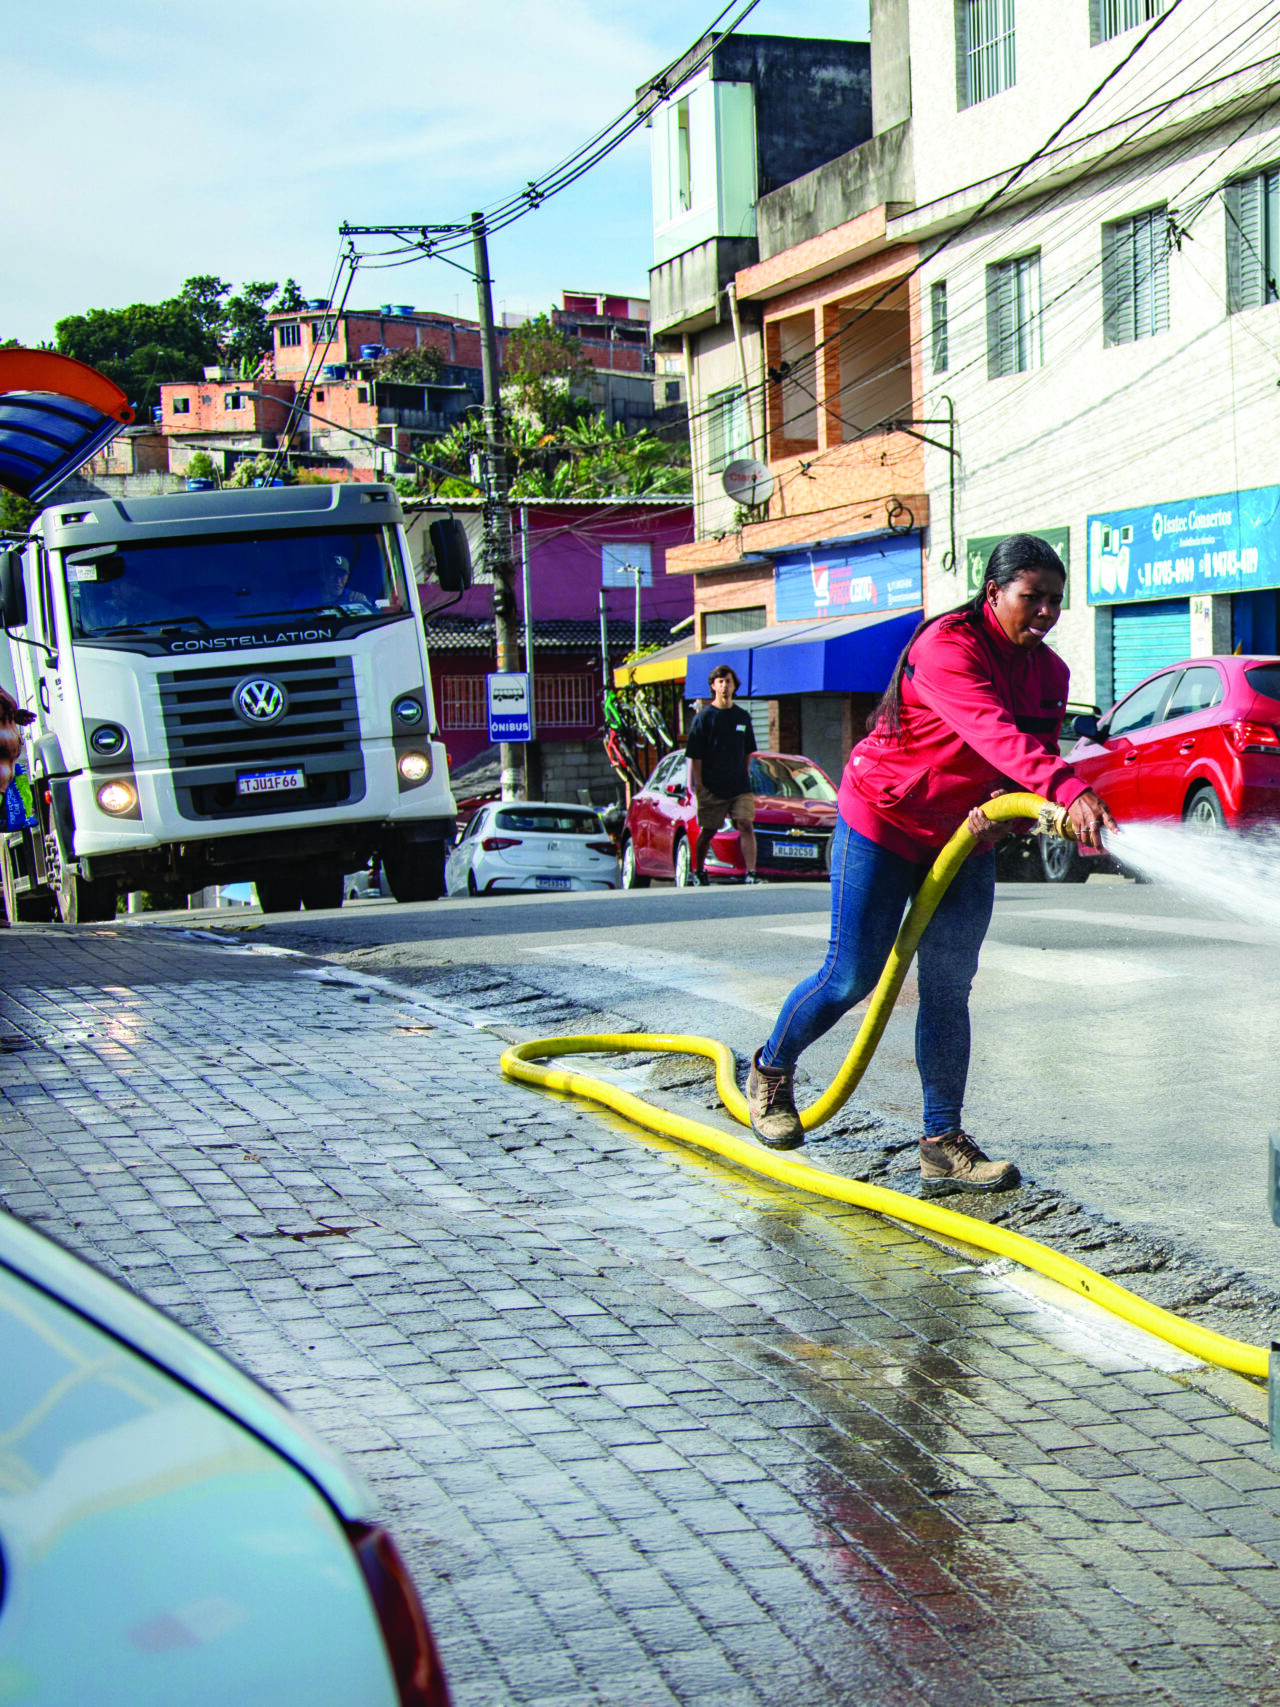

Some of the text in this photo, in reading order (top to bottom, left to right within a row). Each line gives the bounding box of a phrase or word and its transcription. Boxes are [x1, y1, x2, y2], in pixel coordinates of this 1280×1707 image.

[170, 628, 333, 652] CONSTELLATION
[491, 721, 529, 732] ÔNIBUS
[244, 775, 298, 792] TJU1F66
